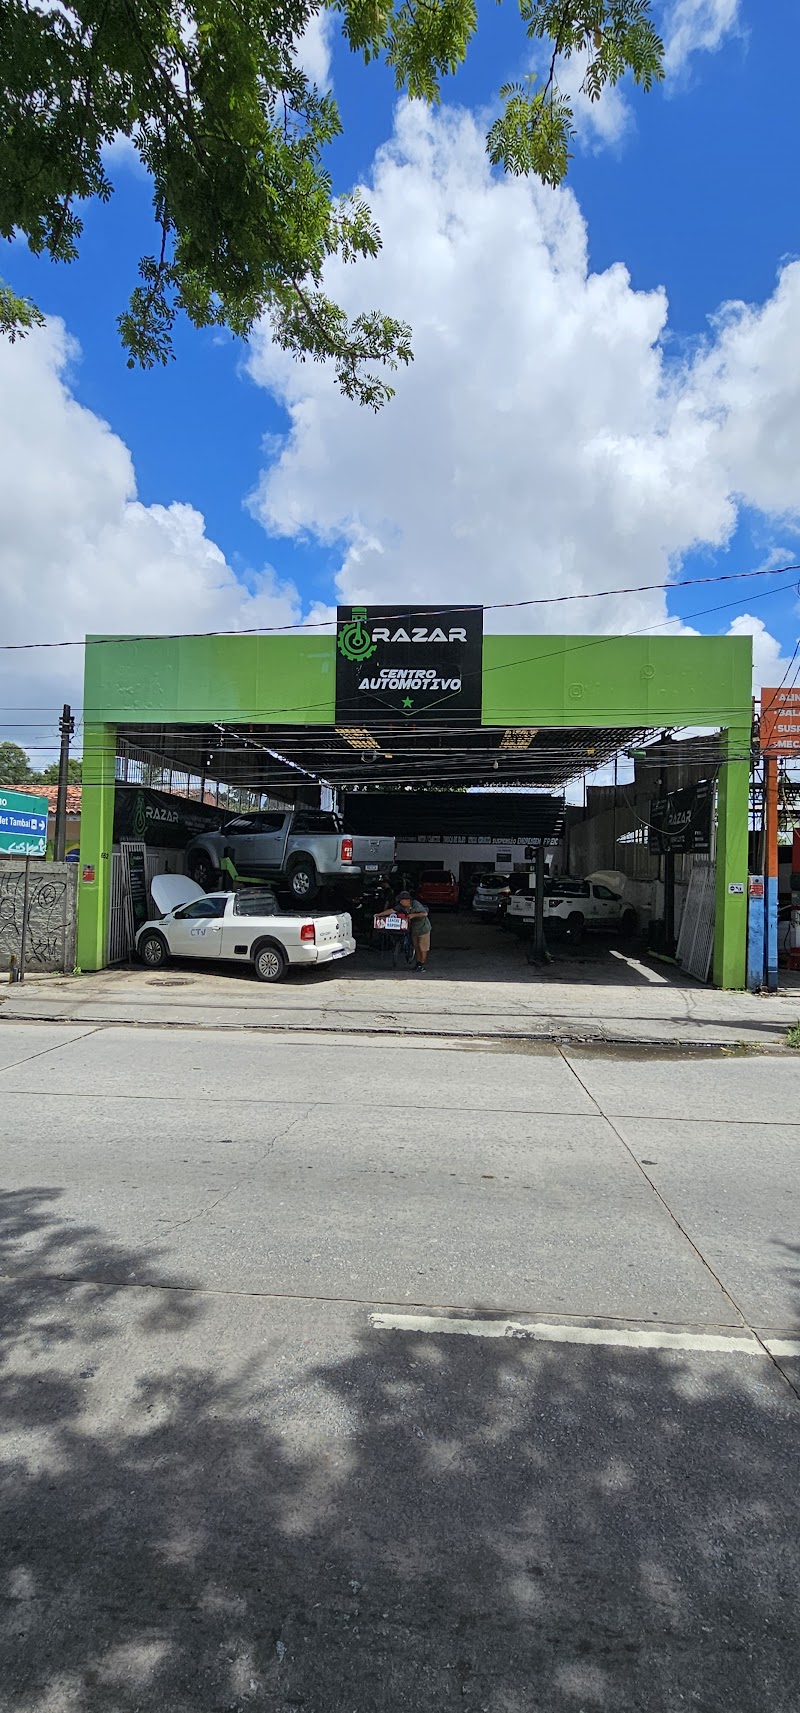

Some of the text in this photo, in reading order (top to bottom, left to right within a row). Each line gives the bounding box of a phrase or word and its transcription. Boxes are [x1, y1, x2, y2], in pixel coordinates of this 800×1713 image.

[371, 627, 467, 642] RAZAR
[380, 669, 437, 679] CENTRO
[358, 678, 462, 690] AUTOMOTIVO
[778, 709, 800, 717] BAL
[145, 806, 179, 823] RAZAR
[668, 810, 692, 826] RAZAR
[191, 928, 207, 936] CTV
